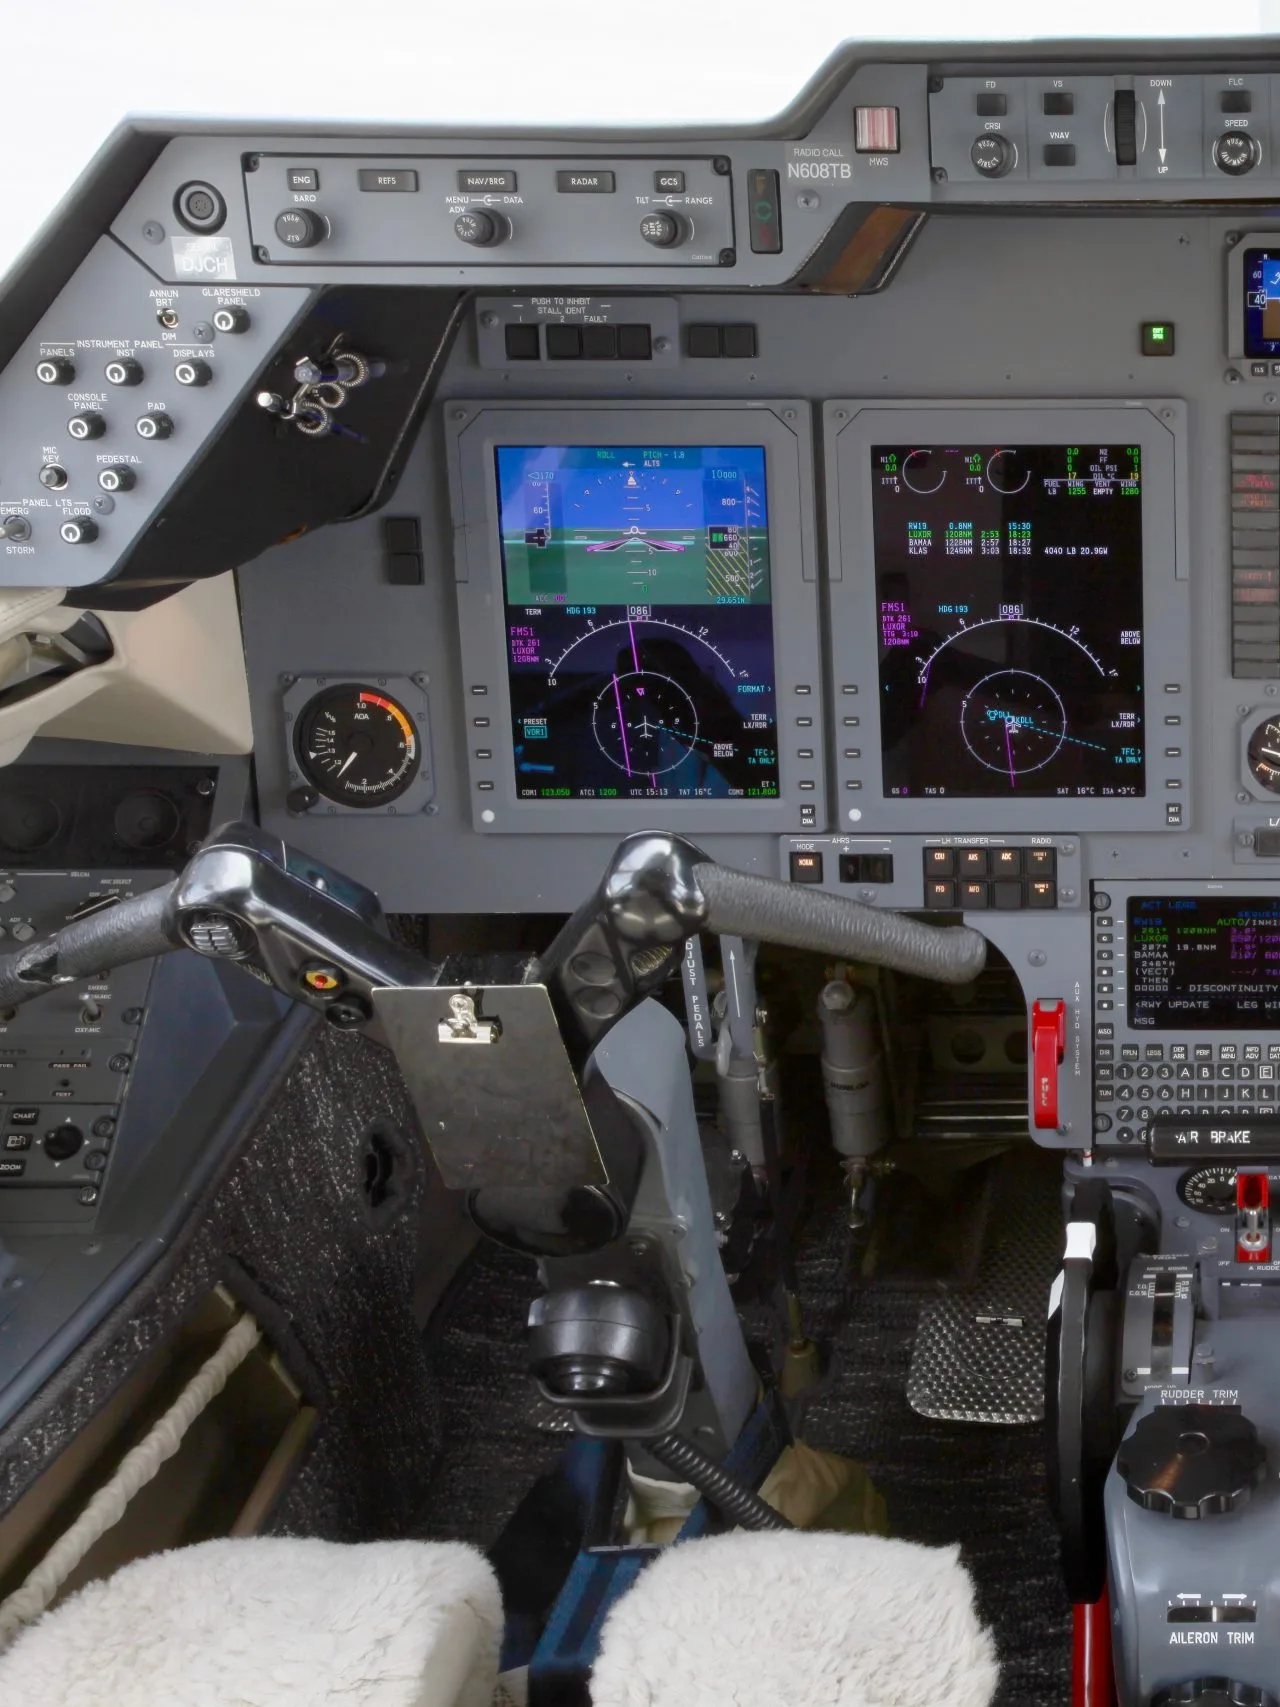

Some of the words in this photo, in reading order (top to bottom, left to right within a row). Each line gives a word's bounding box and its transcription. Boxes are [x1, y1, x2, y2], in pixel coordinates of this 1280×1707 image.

[794, 148, 821, 156] RADIO
[822, 148, 844, 157] CALL
[869, 157, 888, 166] MWS
[788, 163, 851, 179] N608TB
[378, 176, 396, 184] REFS
[467, 176, 506, 186] NAV/BRG
[660, 178, 678, 186] GCS
[182, 256, 228, 273] DJCH
[149, 290, 178, 298] ANNUN
[202, 288, 260, 296] GLARESHIELD
[156, 298, 173, 306] BRT
[217, 297, 246, 305] PANEL
[162, 332, 176, 340] DIM
[76, 340, 130, 348] INSTRUMENT
[135, 340, 164, 348] PANEL
[40, 348, 75, 356] PANELS
[116, 348, 135, 357] INST
[173, 349, 215, 358] DISPLAYS
[68, 393, 108, 402] CONSOLE
[74, 402, 103, 410] PANEL
[147, 402, 166, 410] PAD
[42, 454, 59, 463] KEY
[96, 455, 141, 463] PEDESTAL
[22, 498, 52, 507] PANEL
[55, 499, 72, 507] LTS
[62, 507, 91, 515] FLOOD
[630, 606, 648, 615] 086
[882, 602, 904, 612] FMS1
[1002, 605, 1020, 614] 086
[510, 626, 535, 637] FMS1
[1134, 951, 1168, 959] BAMAA
[1211, 1130, 1250, 1143] BRAKE
[1160, 1390, 1204, 1398] RUDDER
[1213, 1390, 1238, 1398] TRIM
[1169, 1632, 1218, 1644] AILERON
[1227, 1632, 1254, 1644] TRIM
